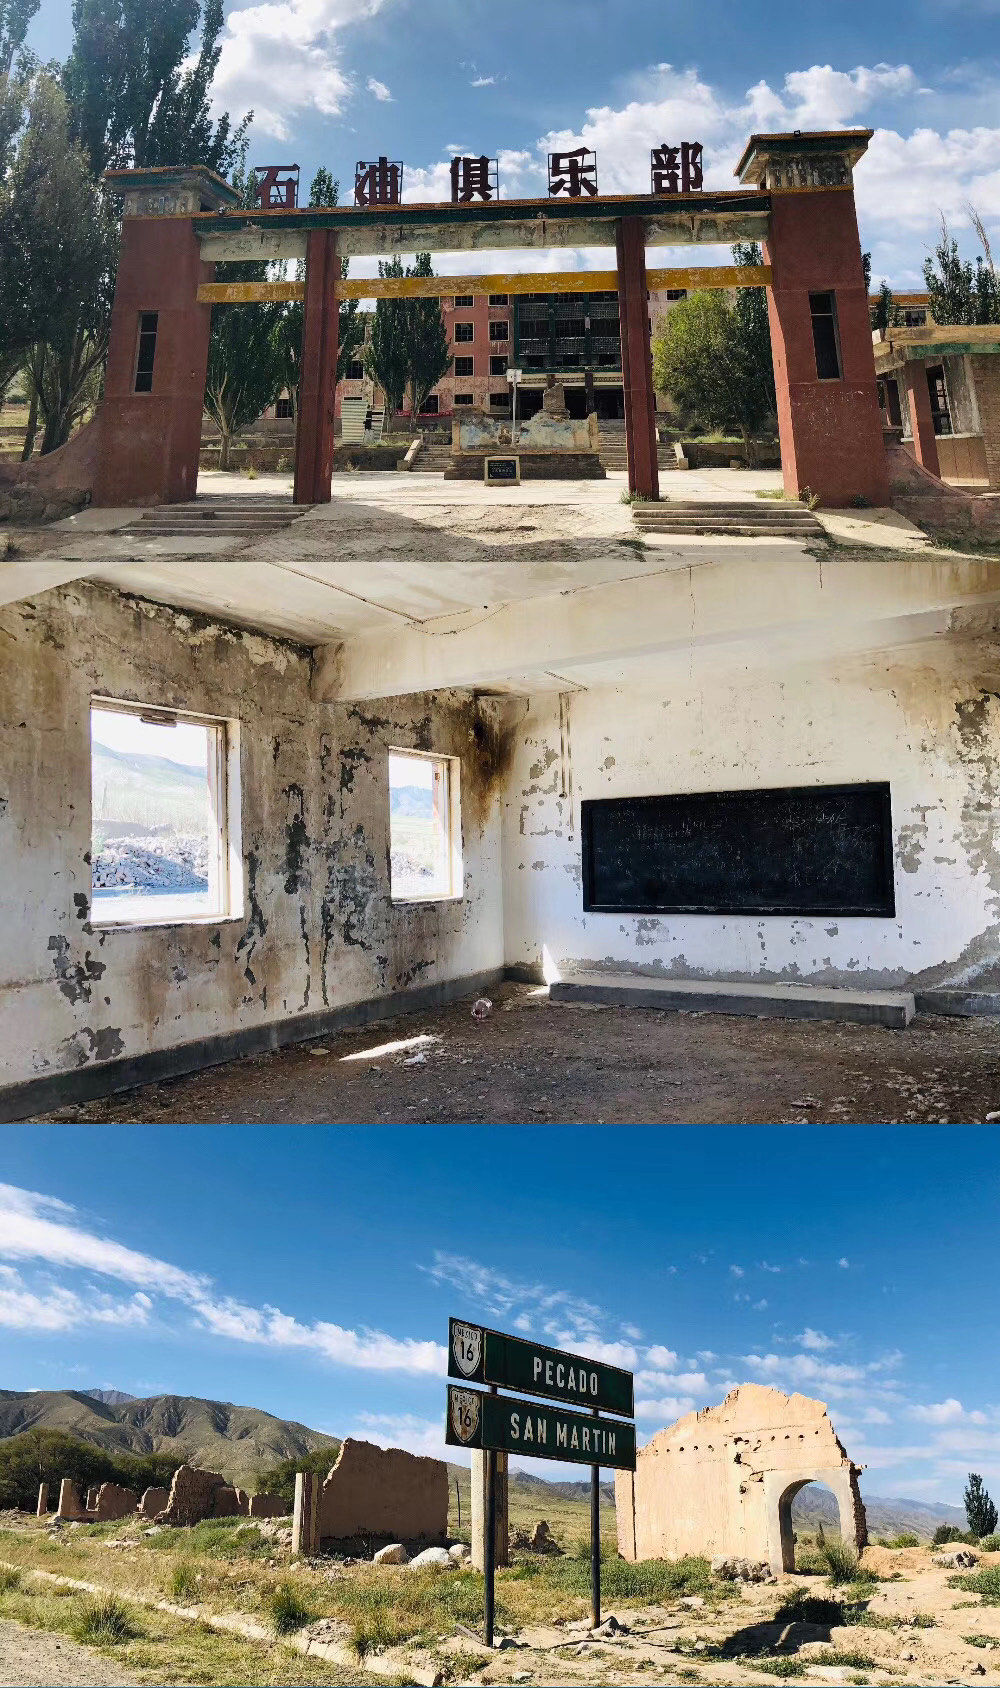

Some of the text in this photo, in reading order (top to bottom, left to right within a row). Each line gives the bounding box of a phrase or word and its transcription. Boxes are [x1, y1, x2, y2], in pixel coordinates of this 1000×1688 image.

[255, 141, 704, 209] 石油俱乐部
[456, 1325, 478, 1341] MEXICO
[460, 1340, 474, 1362] 16
[533, 1356, 598, 1396] PECADO
[457, 1406, 472, 1428] 16
[510, 1413, 616, 1456] SAN MARTIN
